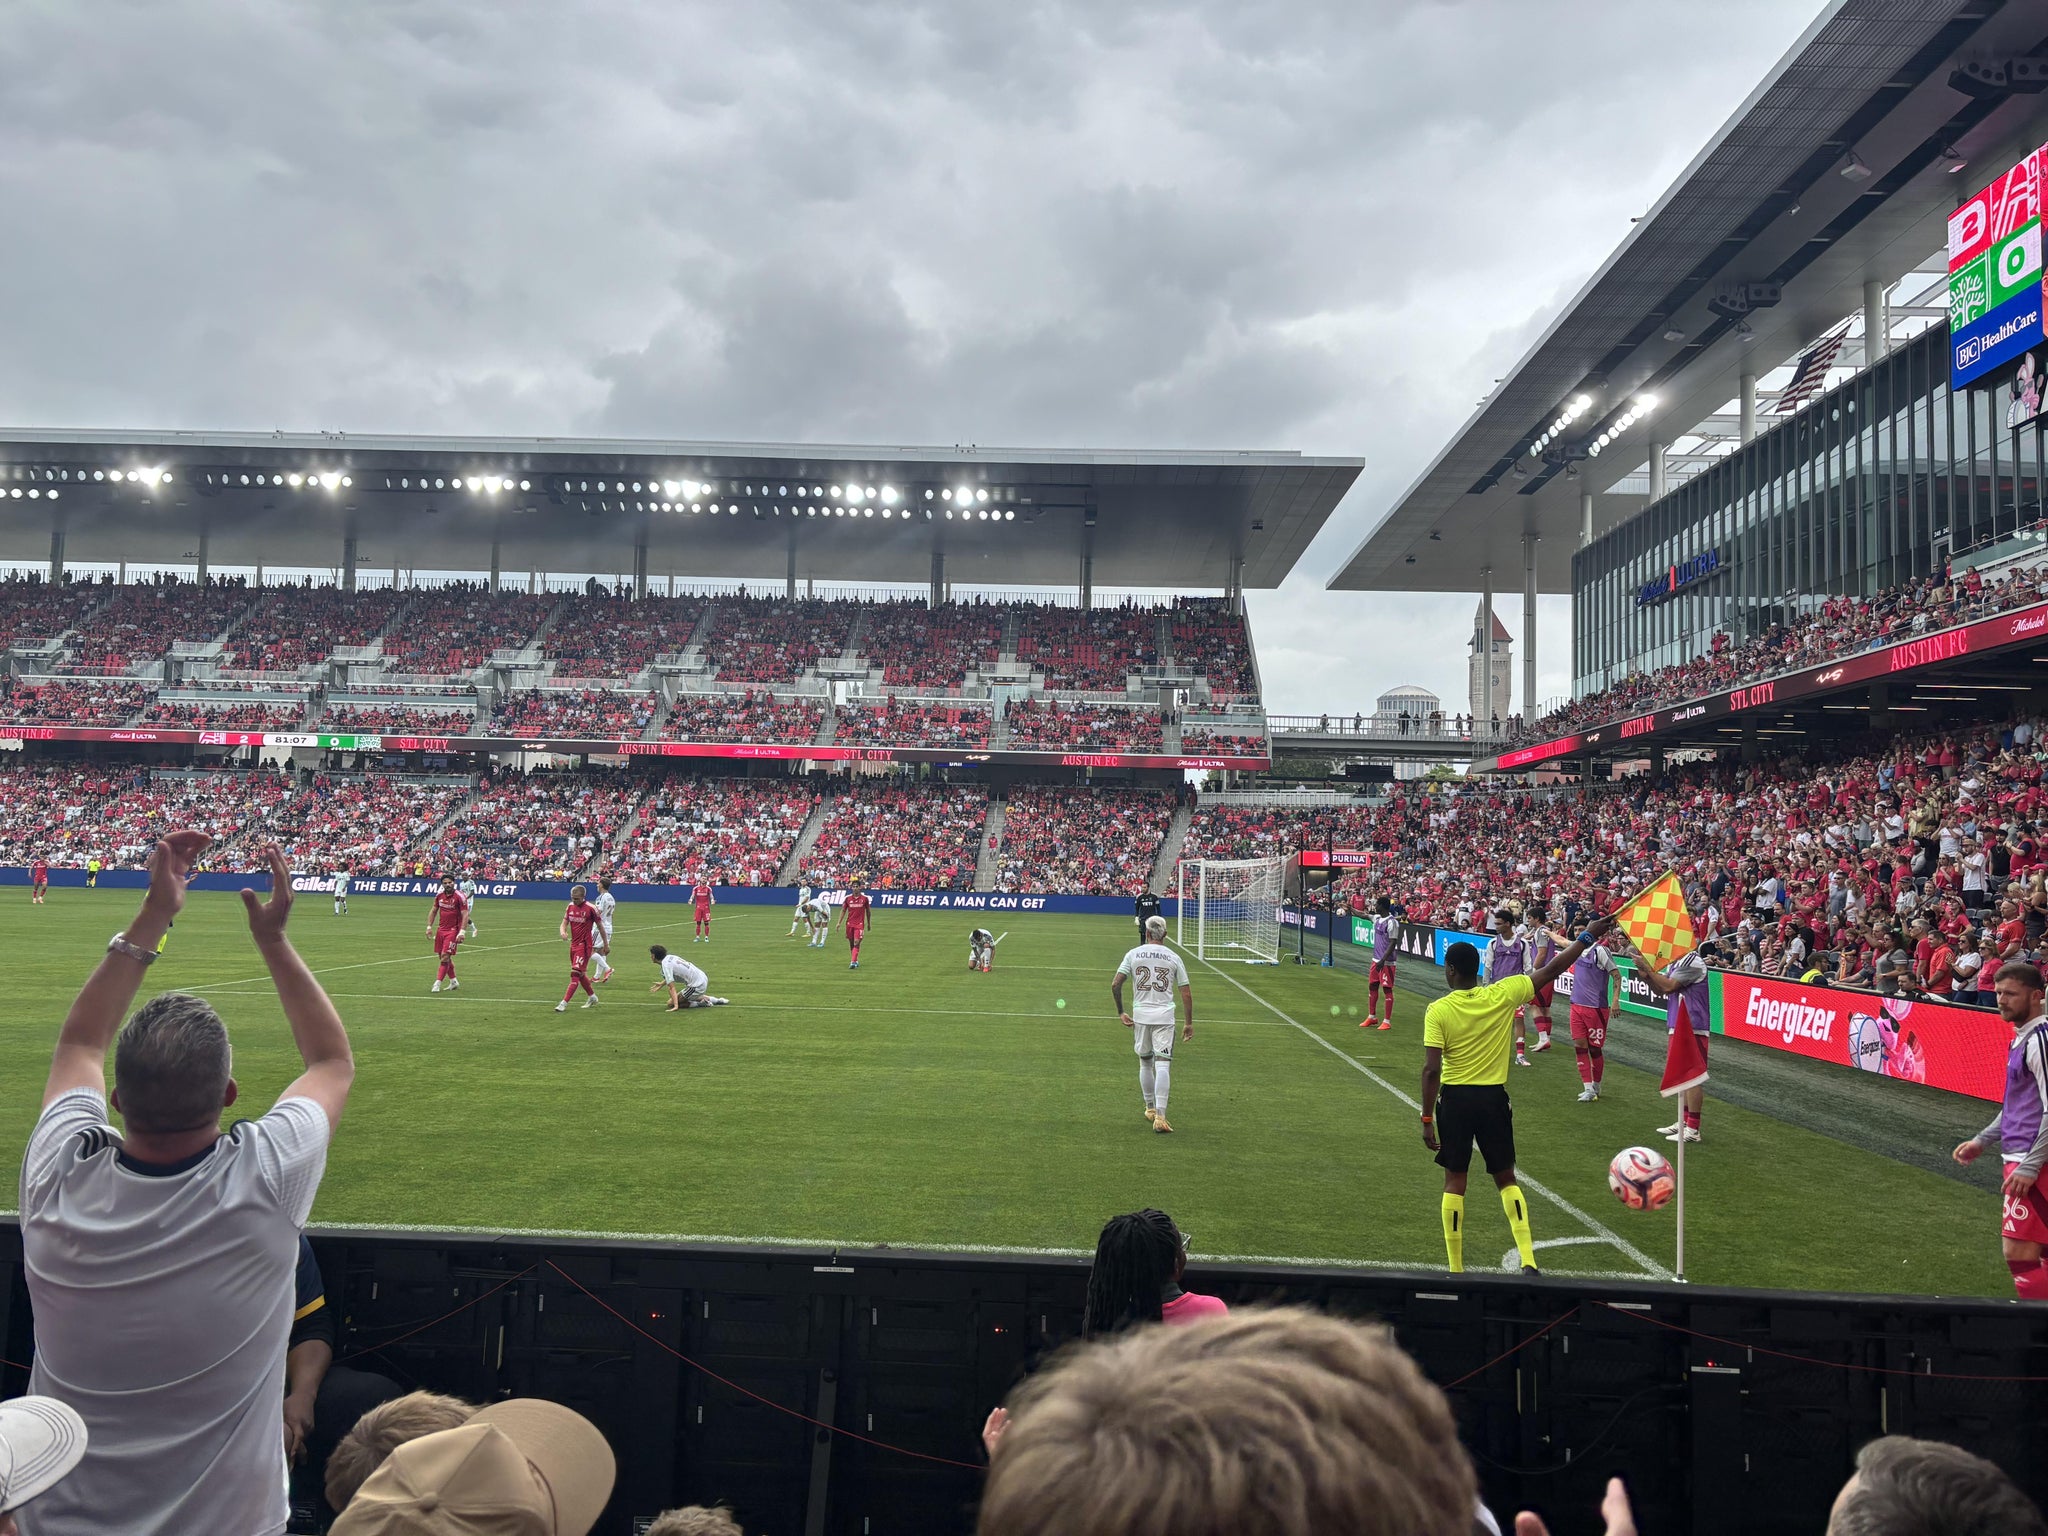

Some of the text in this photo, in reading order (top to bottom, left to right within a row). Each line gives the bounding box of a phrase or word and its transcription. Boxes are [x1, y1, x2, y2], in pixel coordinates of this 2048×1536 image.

[1962, 211, 1978, 244] 2
[2007, 246, 2025, 276] 0
[1959, 311, 2037, 365] BJC HealthCare
[1677, 549, 1719, 585] ULTRA
[1890, 629, 1968, 671] AUSTIN FC
[1730, 682, 1775, 711] STL CITY
[1689, 705, 1706, 718] ULTRA
[0, 728, 54, 739] AUSTIN FC
[1620, 714, 1655, 739] AUSTIN FC
[239, 735, 248, 743] 2
[400, 738, 448, 750] STL CITY
[618, 744, 674, 755] AUSTIN FC
[843, 750, 893, 761] STL CITY
[1061, 756, 1118, 766] AUSTIN FC
[1332, 854, 1365, 863] PURINA
[291, 876, 336, 892] Gillett
[354, 880, 375, 891] THE
[381, 881, 409, 893] BEST
[412, 882, 422, 893] A
[492, 884, 517, 896] GET
[881, 894, 1046, 909] THE BEST A MAN CAN GET
[1136, 966, 1169, 993] 23
[1382, 973, 1388, 982] 4
[1745, 987, 1836, 1044] Energizer
[1588, 1028, 1604, 1040] 28
